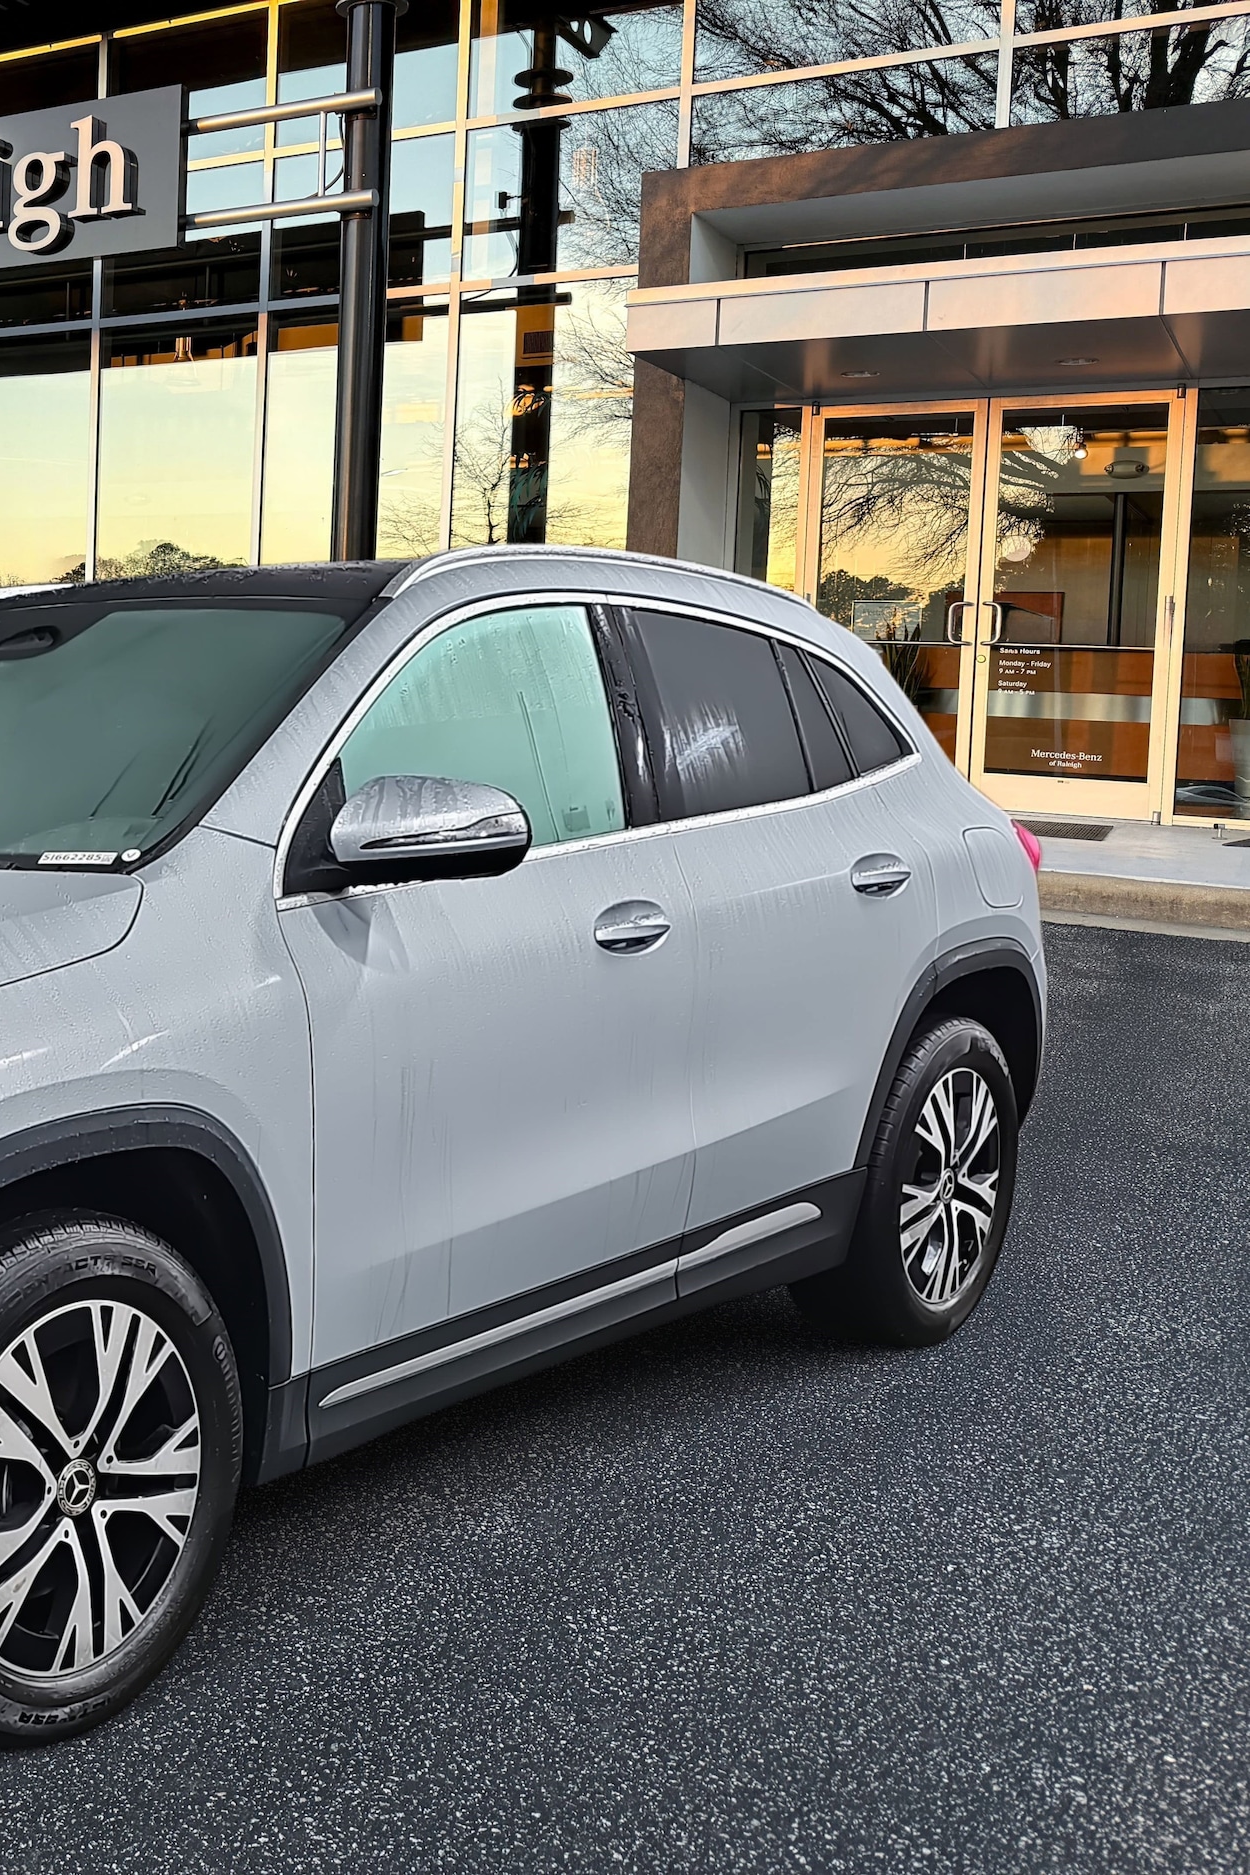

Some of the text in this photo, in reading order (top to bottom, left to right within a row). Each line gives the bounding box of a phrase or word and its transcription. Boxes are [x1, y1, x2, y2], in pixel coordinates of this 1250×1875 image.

[999, 660, 1025, 668] Monday
[1030, 660, 1052, 668] Friday
[997, 680, 1027, 689] Saturday
[1031, 748, 1103, 762] Mercedes-Benz
[1057, 761, 1082, 769] Raleigh
